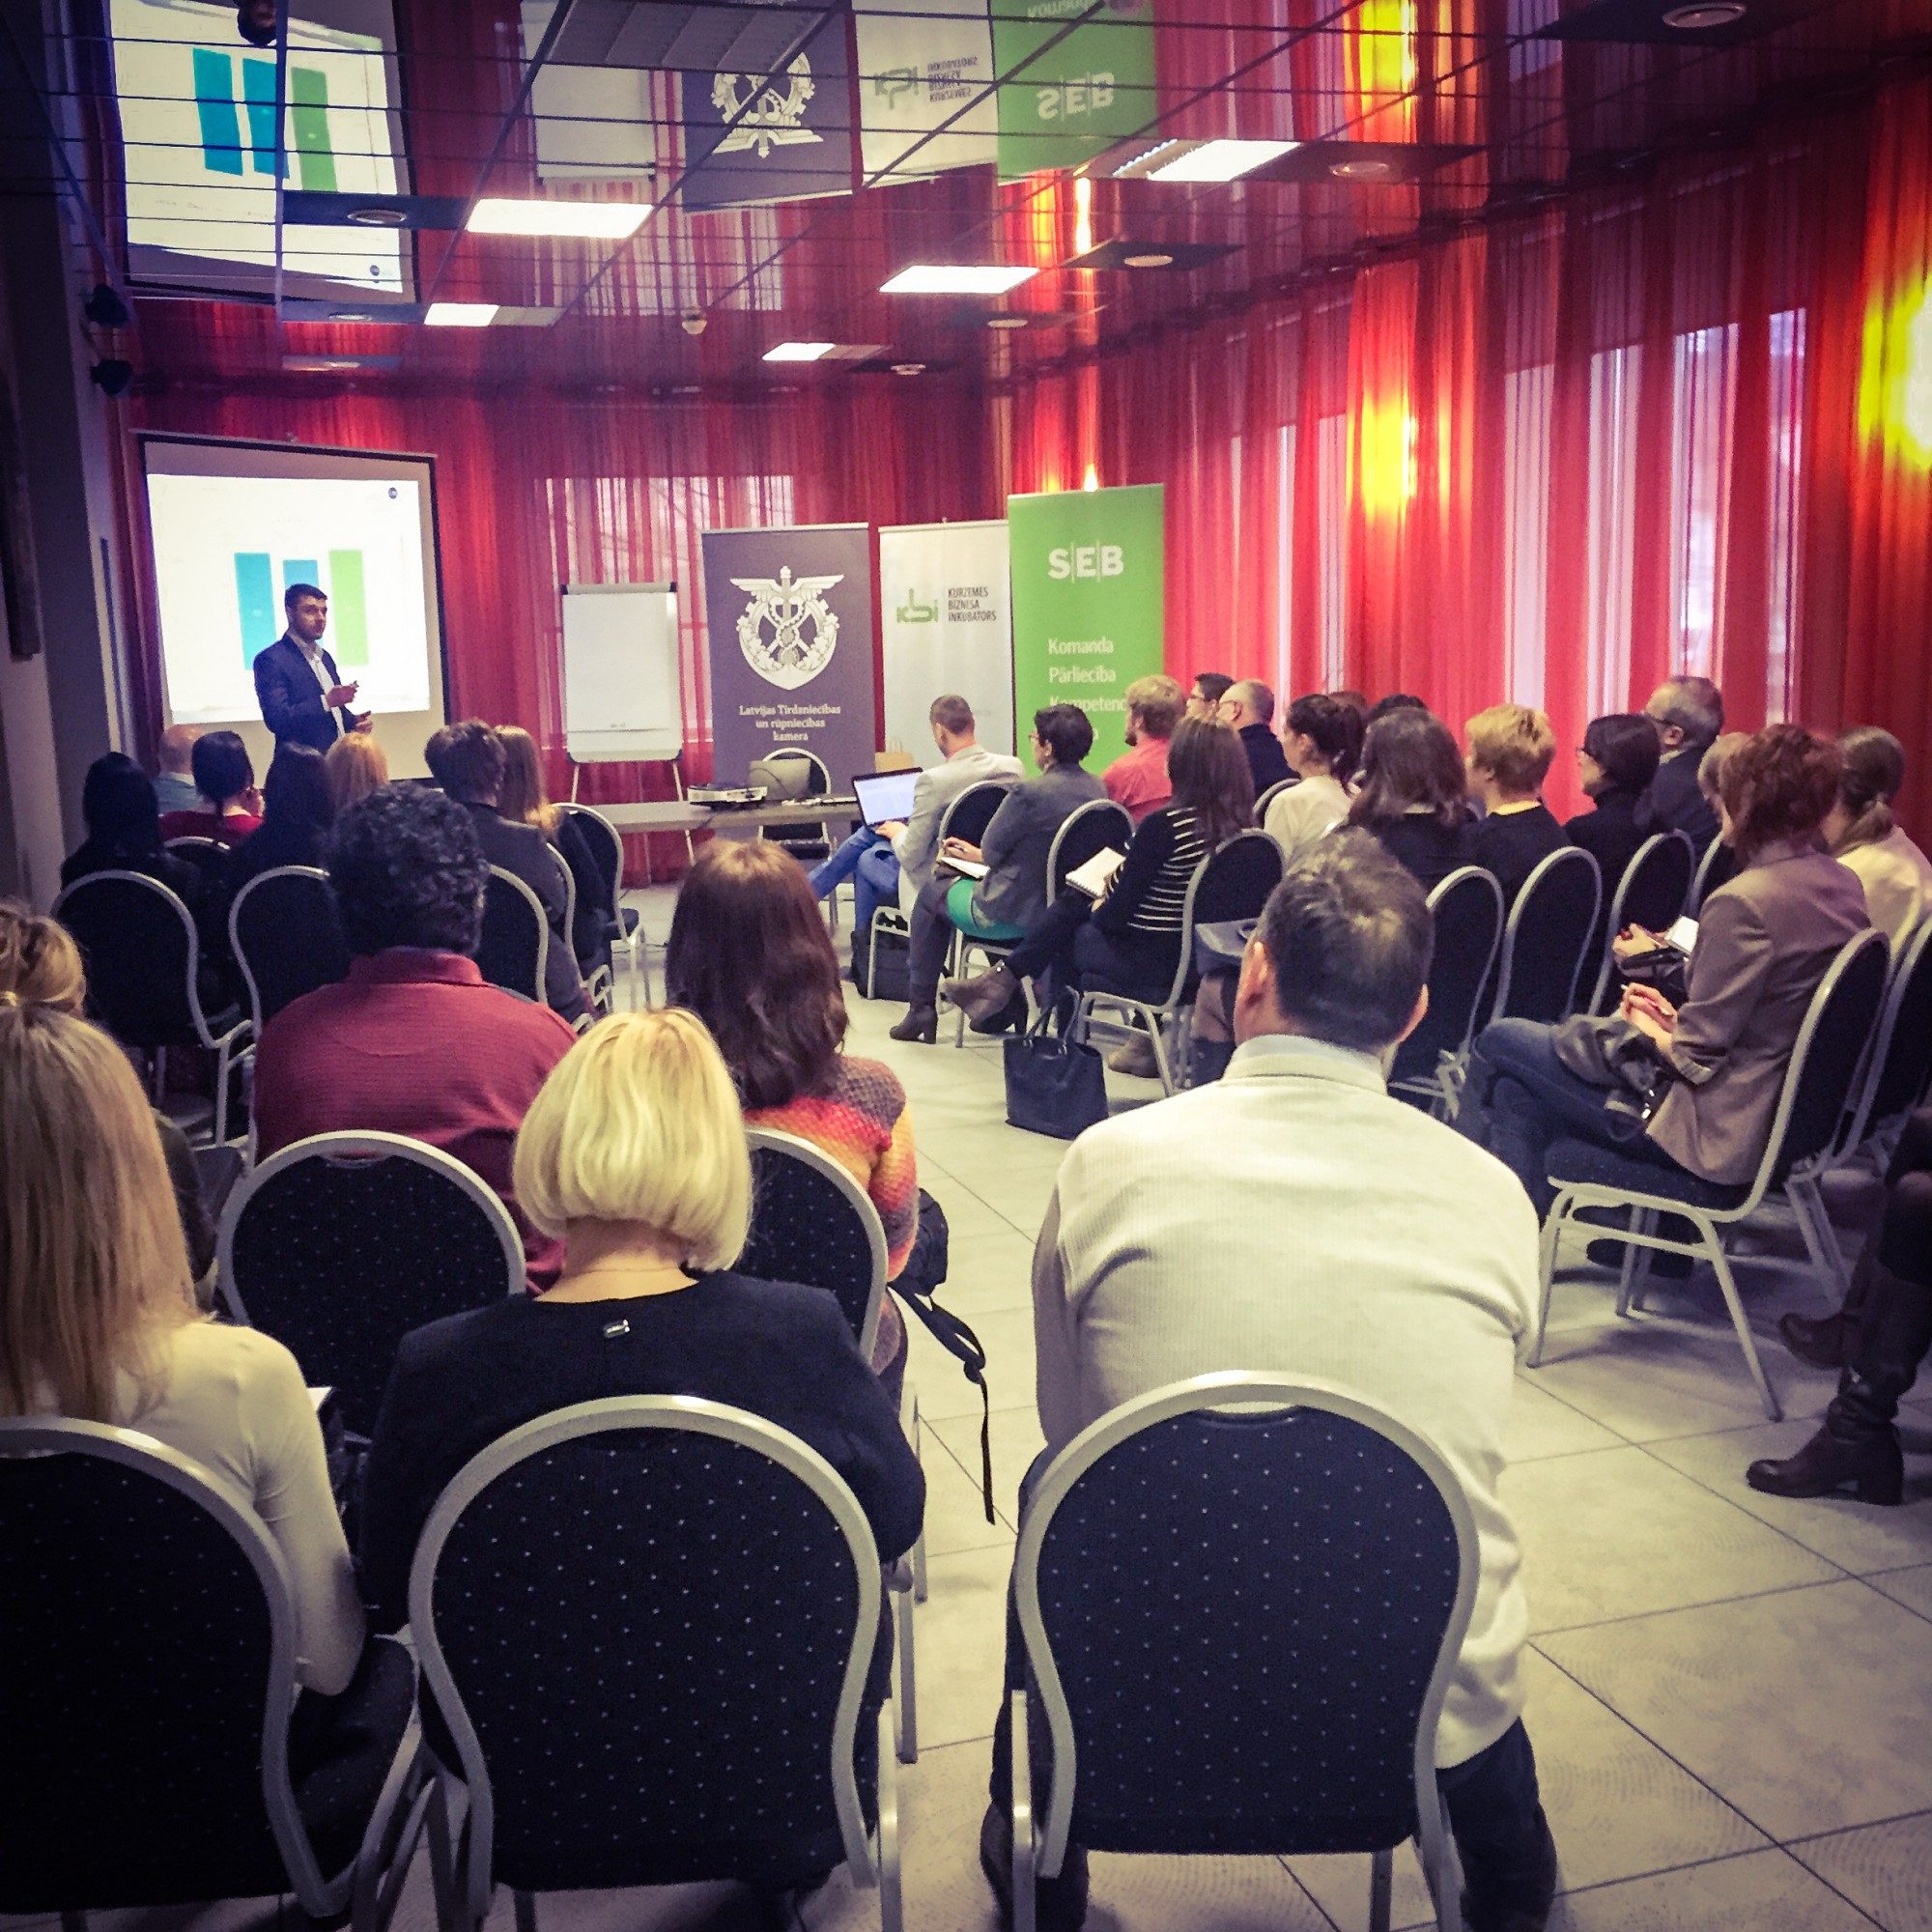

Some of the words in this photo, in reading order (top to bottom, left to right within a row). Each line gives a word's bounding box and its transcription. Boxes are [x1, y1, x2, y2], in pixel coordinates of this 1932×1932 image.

[948, 587, 988, 598] KURZEMES
[948, 599, 980, 610] BIZNESA
[948, 611, 997, 622] INKUBATORS
[1048, 637, 1114, 654] Komanda
[1048, 665, 1116, 683] Pārliecība
[739, 705, 776, 717] Latvijas
[755, 719, 769, 728] un
[773, 731, 809, 741] kamera
